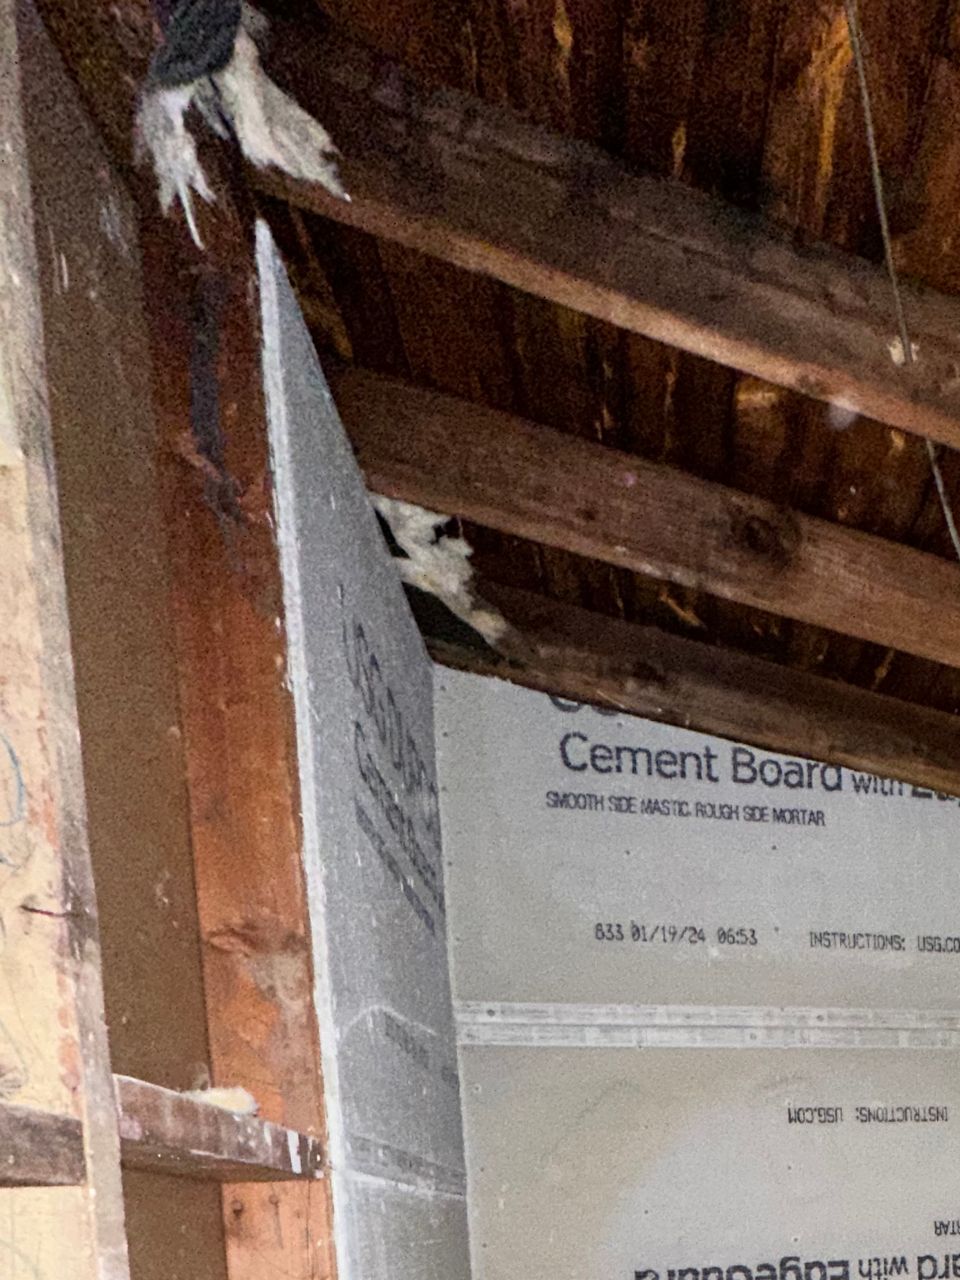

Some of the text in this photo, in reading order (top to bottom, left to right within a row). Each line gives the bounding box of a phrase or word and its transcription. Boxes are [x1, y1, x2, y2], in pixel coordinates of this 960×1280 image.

[559, 732, 718, 783] Cement
[731, 746, 843, 792] Board
[545, 790, 604, 811] SMOOTH
[608, 795, 635, 815] SIDE
[695, 801, 740, 822] ROUGH
[743, 805, 769, 823] SIDE
[773, 807, 826, 827] MORTAR
[630, 923, 706, 944] 01/19/24
[717, 927, 758, 946] 06:53
[809, 931, 906, 951] INSTRUCTIONS:
[787, 1107, 843, 1124] USG.COM
[855, 1106, 949, 1123] INSTRUCTIONS:
[857, 1261, 910, 1280] with
